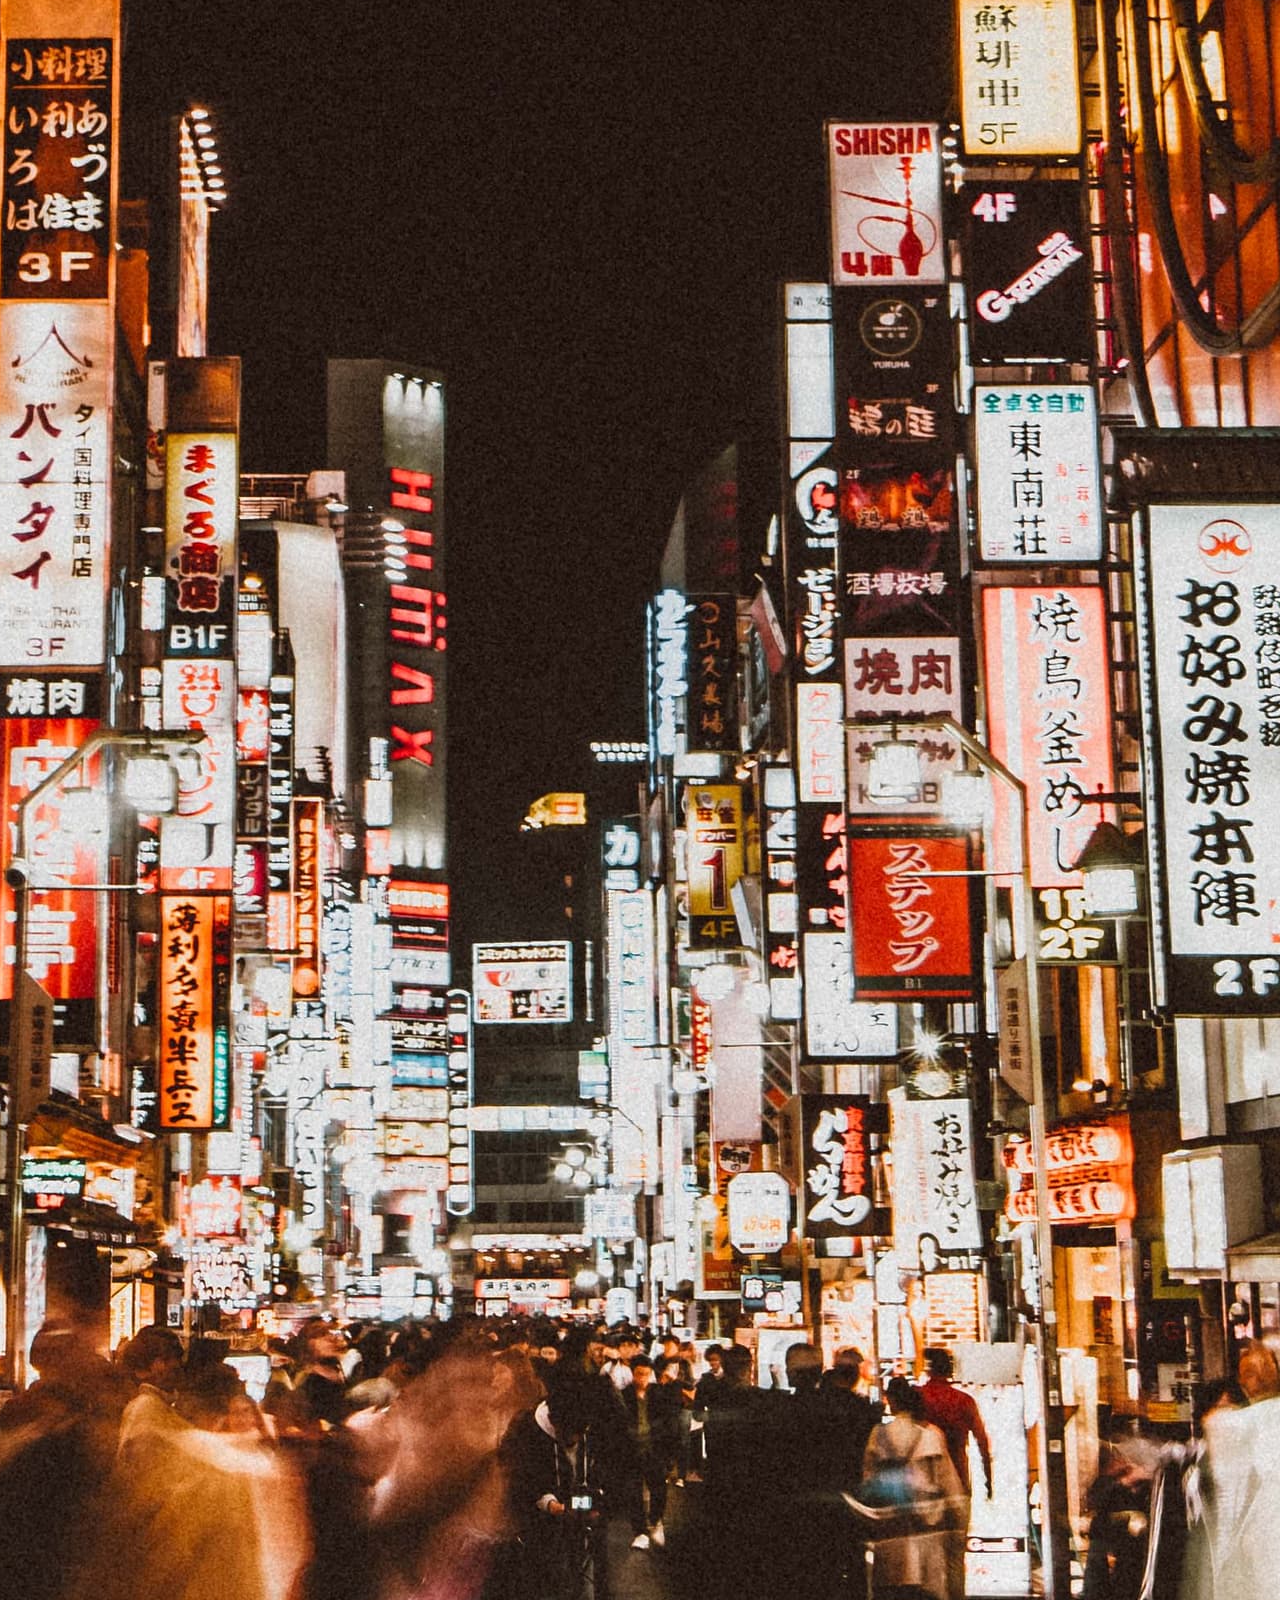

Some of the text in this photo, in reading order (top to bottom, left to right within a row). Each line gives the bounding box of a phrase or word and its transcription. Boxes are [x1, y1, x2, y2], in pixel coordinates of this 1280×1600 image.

[10, 46, 110, 82] 小料理
[834, 126, 933, 156] SHISHA
[979, 122, 1019, 145] 5F
[971, 193, 1018, 222] 4F
[18, 251, 94, 284] 3F
[983, 392, 1086, 415] 全卓全自動
[9, 401, 62, 591] バンタイ
[1007, 421, 1049, 557] 東南荘
[176, 443, 220, 613] まぐろ商店
[26, 637, 67, 657] 3F
[169, 624, 228, 650] B1F
[853, 647, 953, 695] 焼肉
[6, 678, 87, 715] 焼肉
[1031, 592, 1085, 873] 焼鳥釜めし
[1176, 578, 1261, 928] お好み焼本陣
[177, 868, 218, 890] 4F
[702, 847, 727, 911] 1
[883, 842, 940, 974] ステップ
[700, 920, 736, 939] 4F
[1039, 926, 1106, 960] 2F
[1212, 958, 1280, 996] 2F
